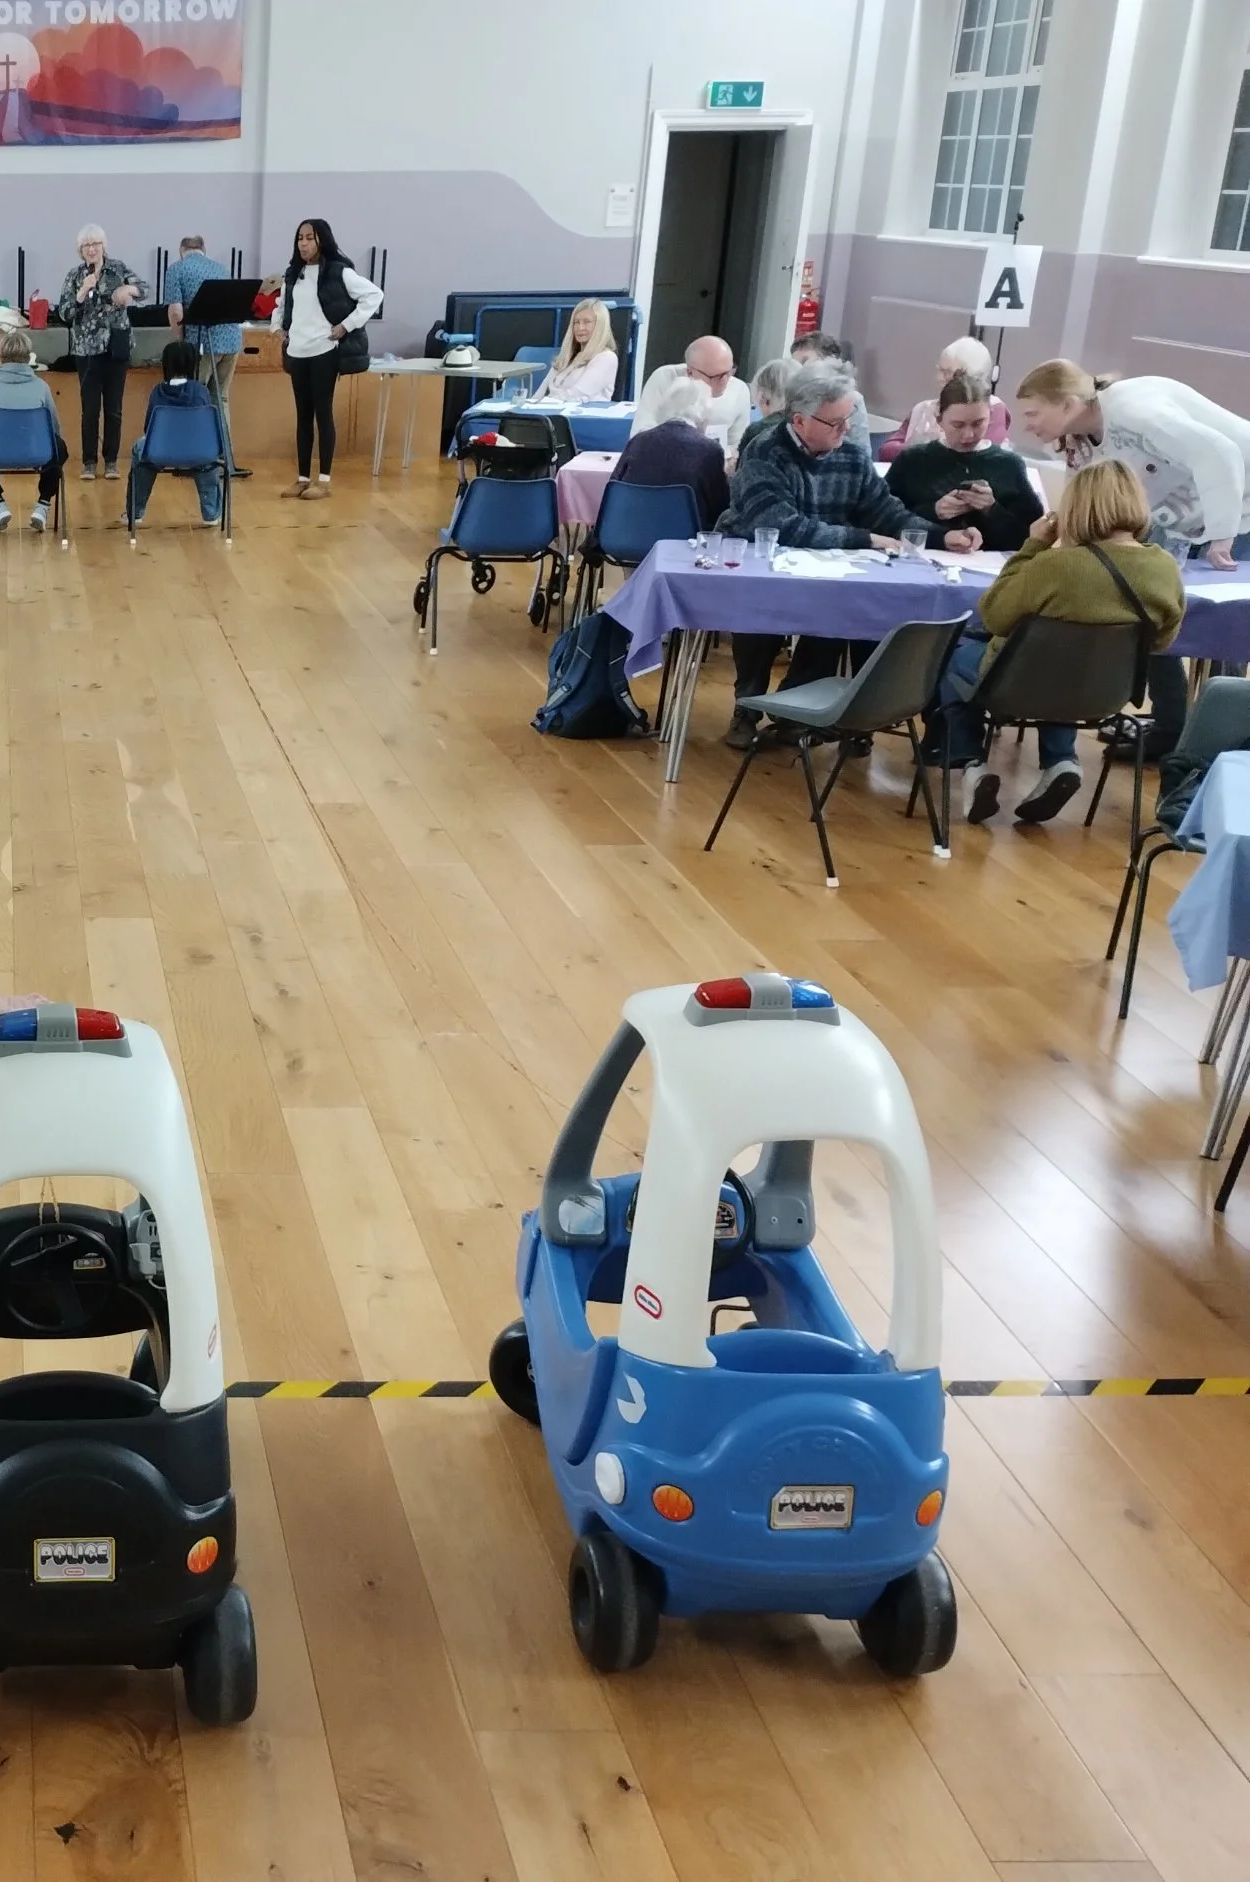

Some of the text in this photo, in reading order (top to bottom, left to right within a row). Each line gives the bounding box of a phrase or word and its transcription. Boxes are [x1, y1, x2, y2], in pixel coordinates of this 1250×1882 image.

[45, 0, 238, 25] TOMORROW
[984, 266, 1025, 310] A
[778, 1491, 847, 1513] POLICE
[40, 1543, 110, 1566] POLICE
